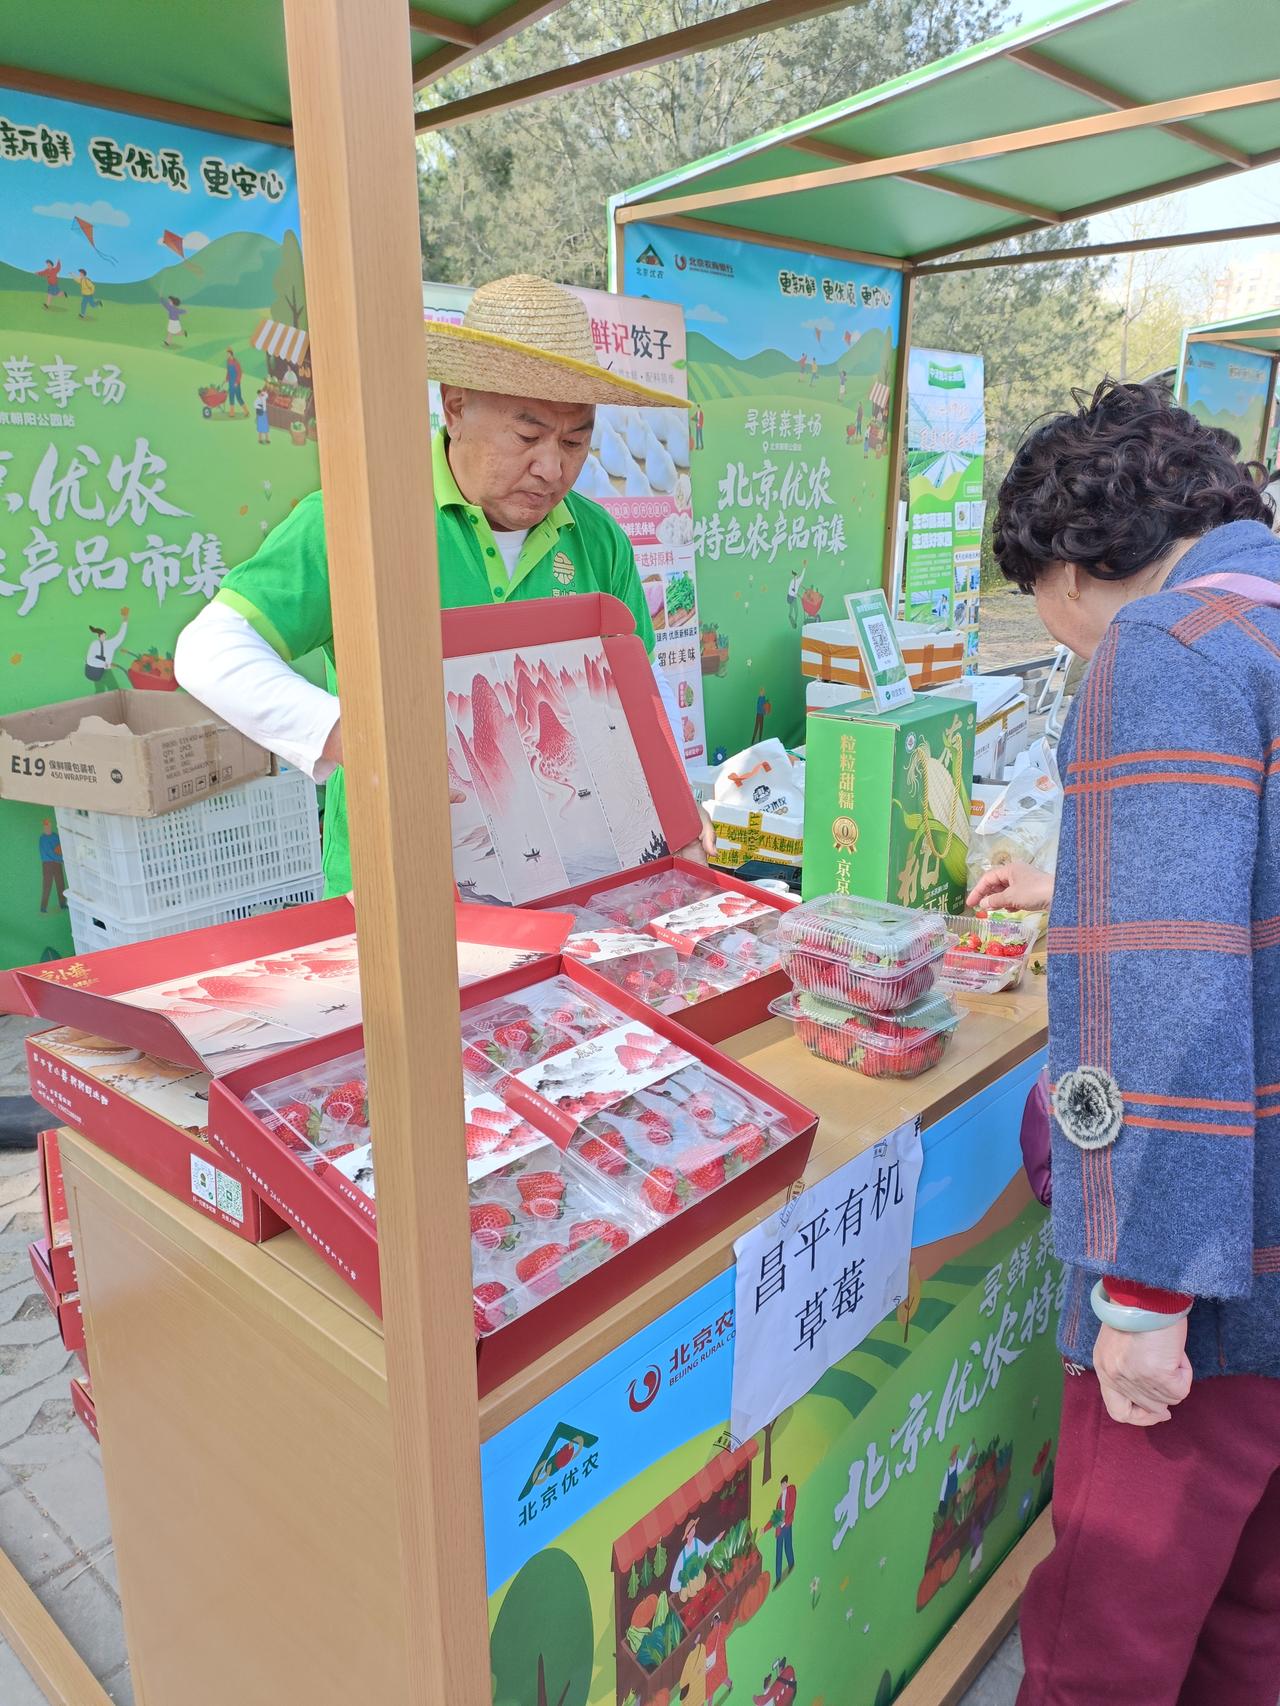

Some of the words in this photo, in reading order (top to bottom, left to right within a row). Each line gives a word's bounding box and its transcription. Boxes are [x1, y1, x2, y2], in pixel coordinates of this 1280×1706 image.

[92, 140, 187, 189] 更优质
[203, 160, 283, 199] 更安心
[780, 272, 816, 296] 更新鲜
[823, 280, 856, 305] 更优质
[2, 354, 126, 408] 菜事场
[744, 408, 822, 440] 寻鲜菜事场
[718, 456, 837, 511] 北京优农
[694, 510, 848, 564] 特色农产品市集
[658, 647, 696, 667] 留住美味
[11, 755, 46, 777] E19
[51, 771, 62, 780] 450
[64, 773, 97, 784] WRAPPER
[755, 1160, 904, 1315] 昌平有机
[793, 1258, 866, 1351] 草莓
[670, 1308, 734, 1374] 北京农
[670, 1358, 699, 1387] BEIJING
[700, 1338, 725, 1363] RURAL
[832, 1302, 1026, 1551] 北京优农
[518, 1451, 599, 1527] 北京优农
